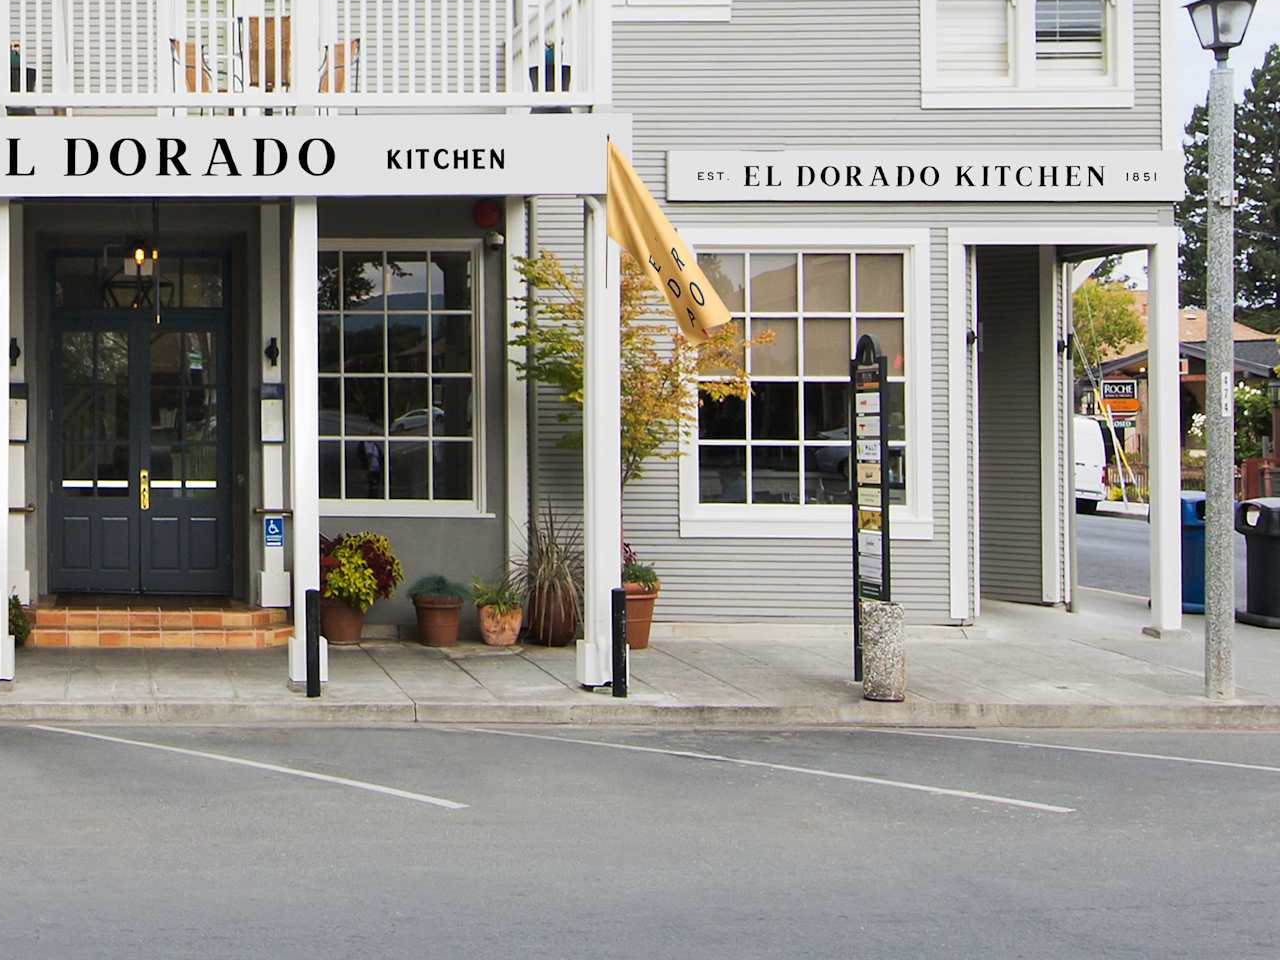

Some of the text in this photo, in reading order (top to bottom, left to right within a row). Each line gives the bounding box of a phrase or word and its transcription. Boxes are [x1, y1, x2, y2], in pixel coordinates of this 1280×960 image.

[63, 137, 336, 177] DORADO
[386, 148, 505, 170] KITCHEN
[697, 165, 1157, 188] EST. EL DORADO KITCHEN 1851
